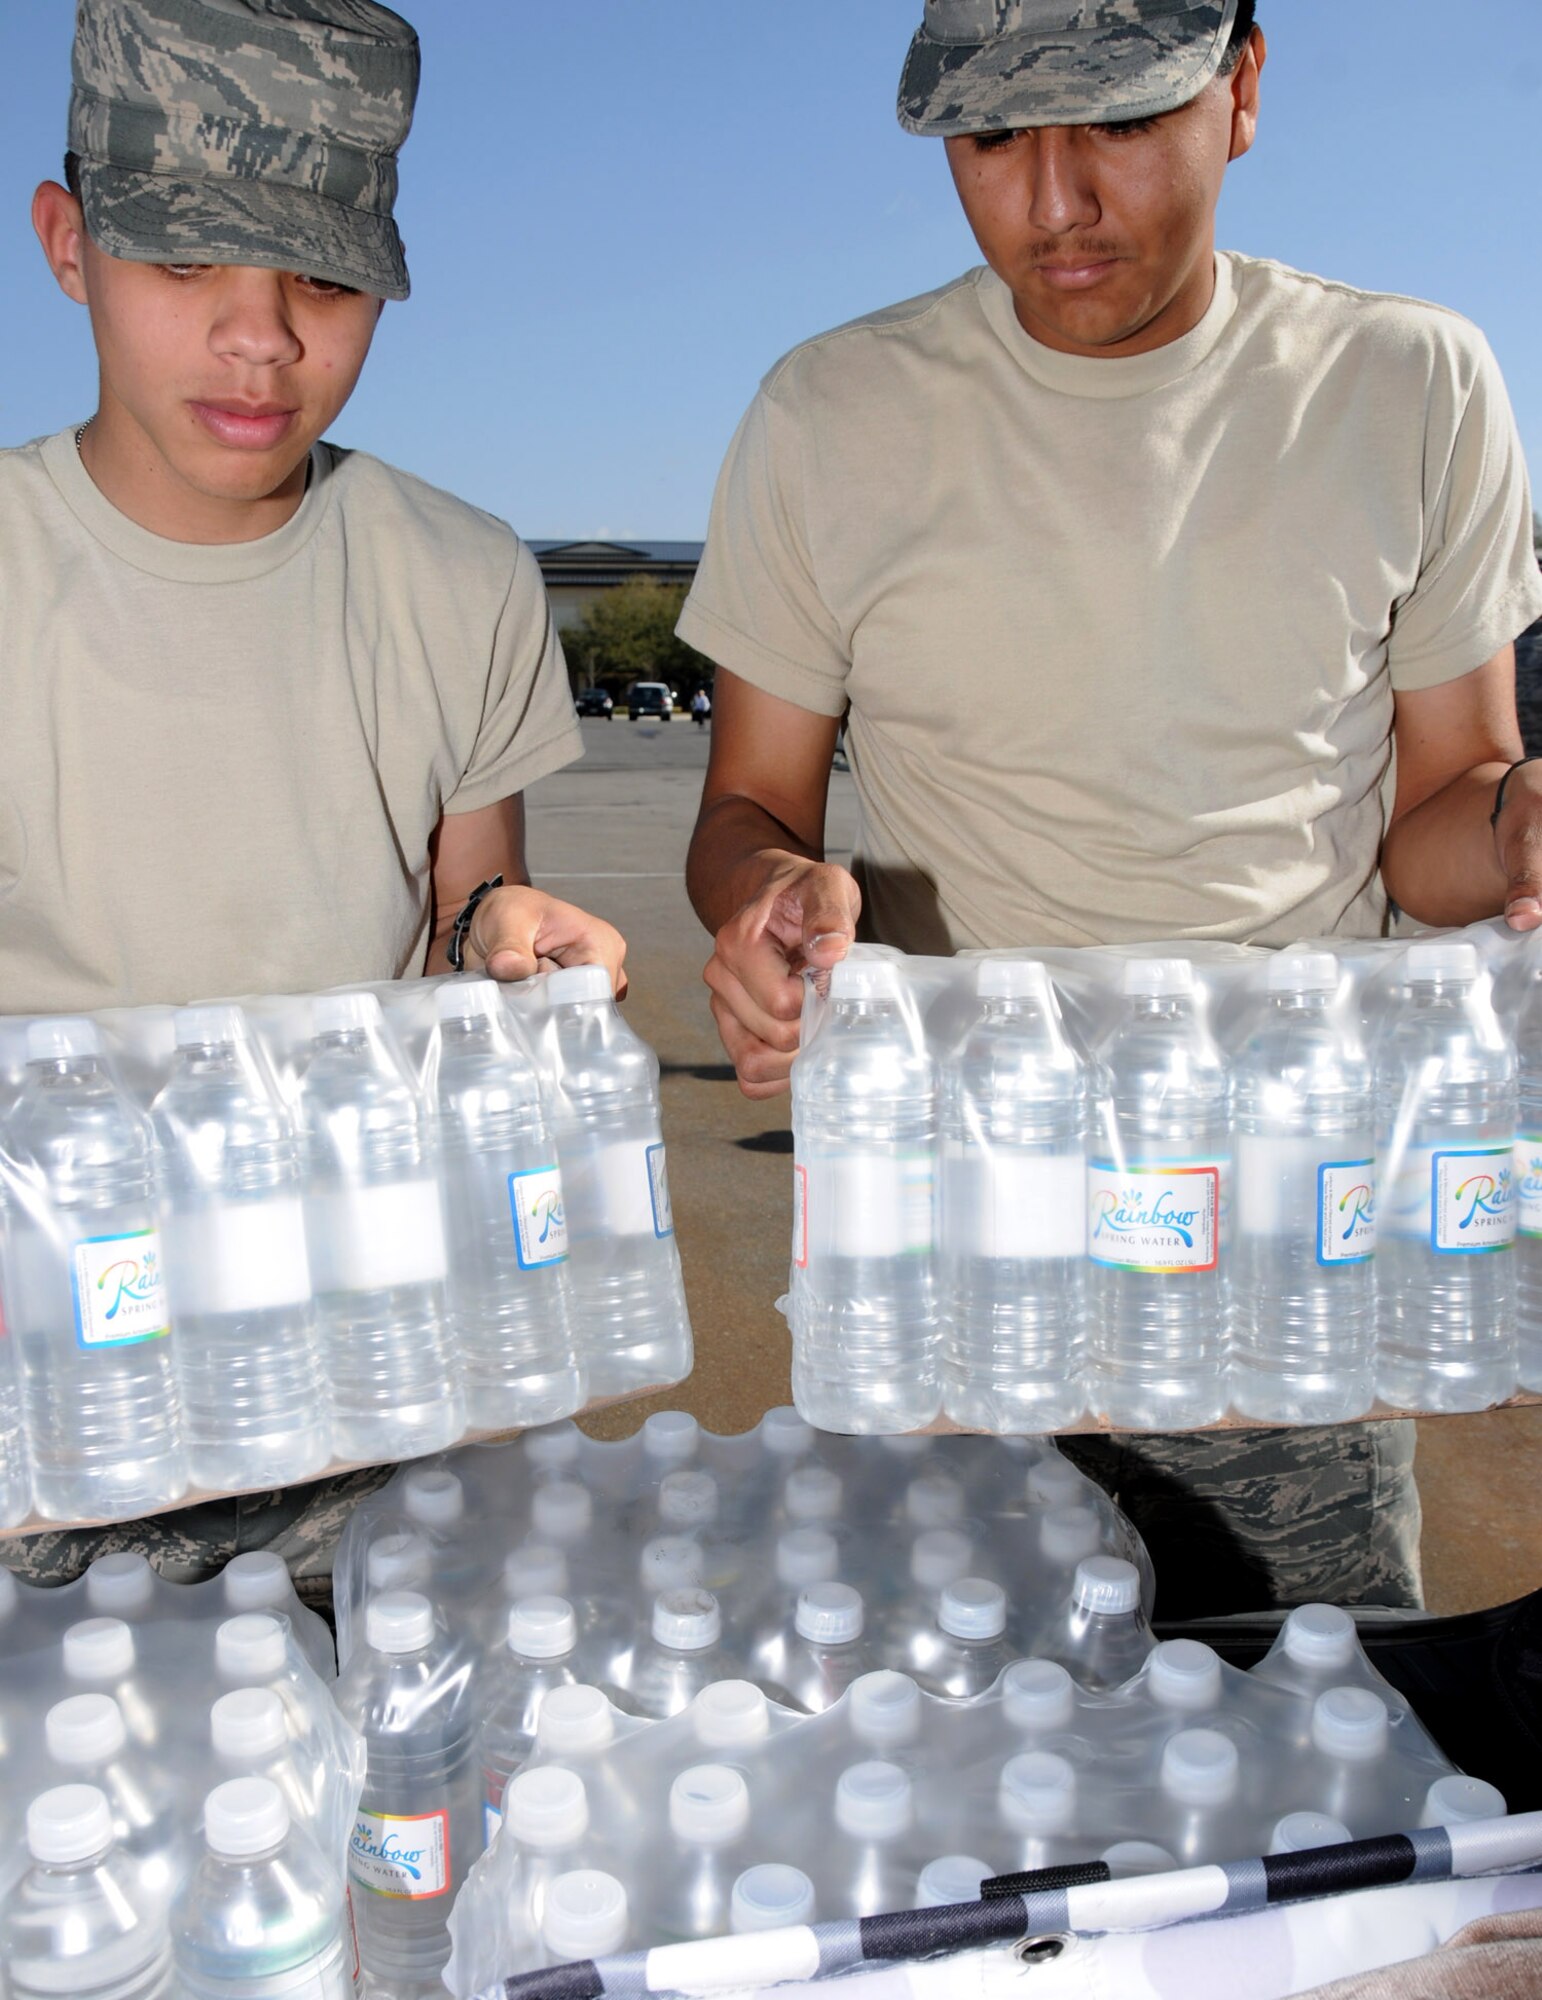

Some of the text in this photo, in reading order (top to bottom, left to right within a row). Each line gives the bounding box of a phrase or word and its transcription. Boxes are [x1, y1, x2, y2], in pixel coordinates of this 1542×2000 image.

[1092, 1189, 1199, 1248] Rainbow
[1141, 1237, 1182, 1248] WATER
[350, 1832, 426, 1880] ainbow
[373, 1865, 407, 1878] WATER
